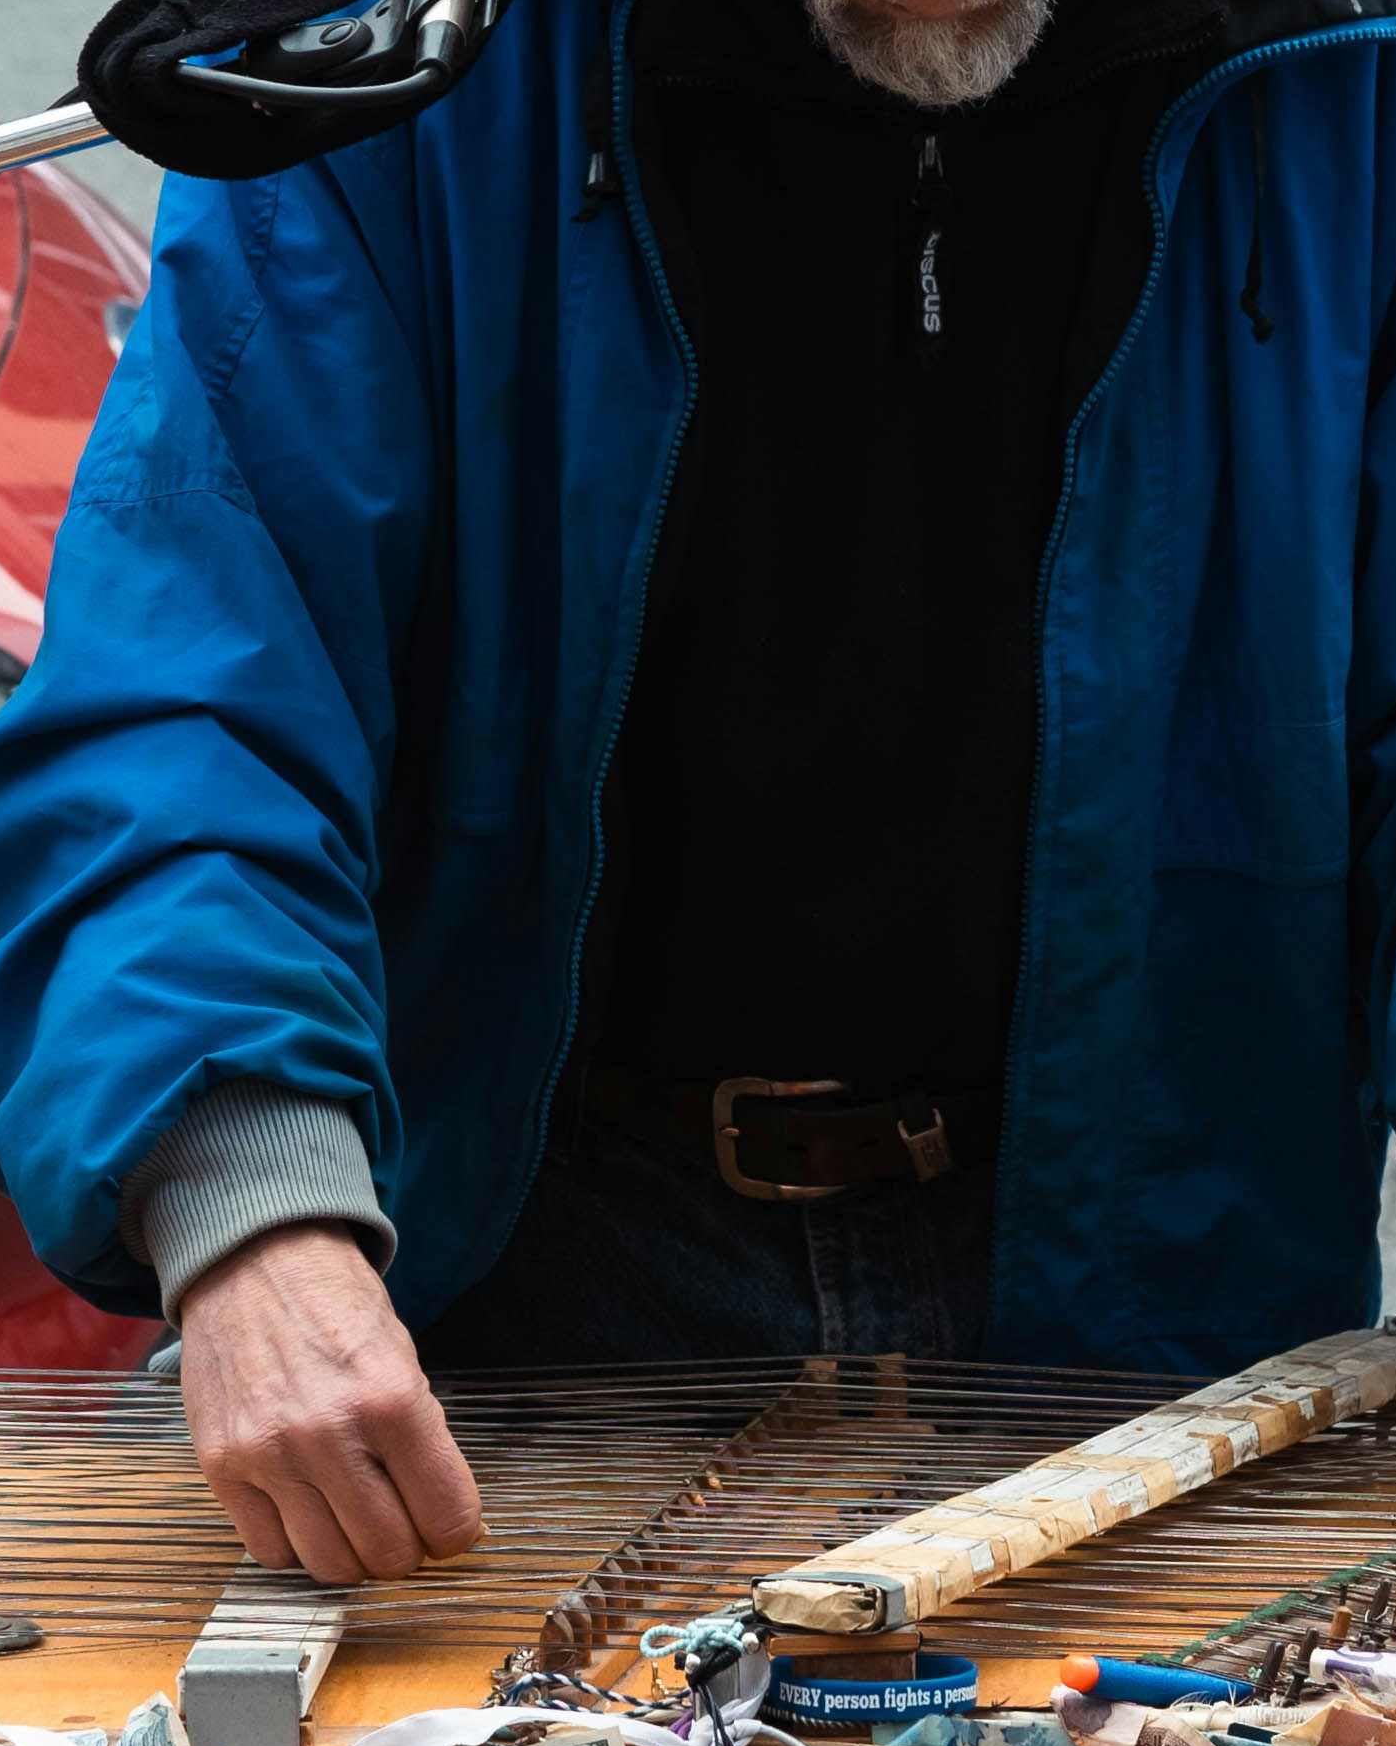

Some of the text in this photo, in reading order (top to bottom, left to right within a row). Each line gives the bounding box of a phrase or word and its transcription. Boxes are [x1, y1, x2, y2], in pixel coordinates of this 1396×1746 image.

[779, 1681, 821, 1707] EVERY
[824, 1692, 880, 1713] person
[884, 1686, 930, 1712] fights
[933, 1688, 942, 1704] a
